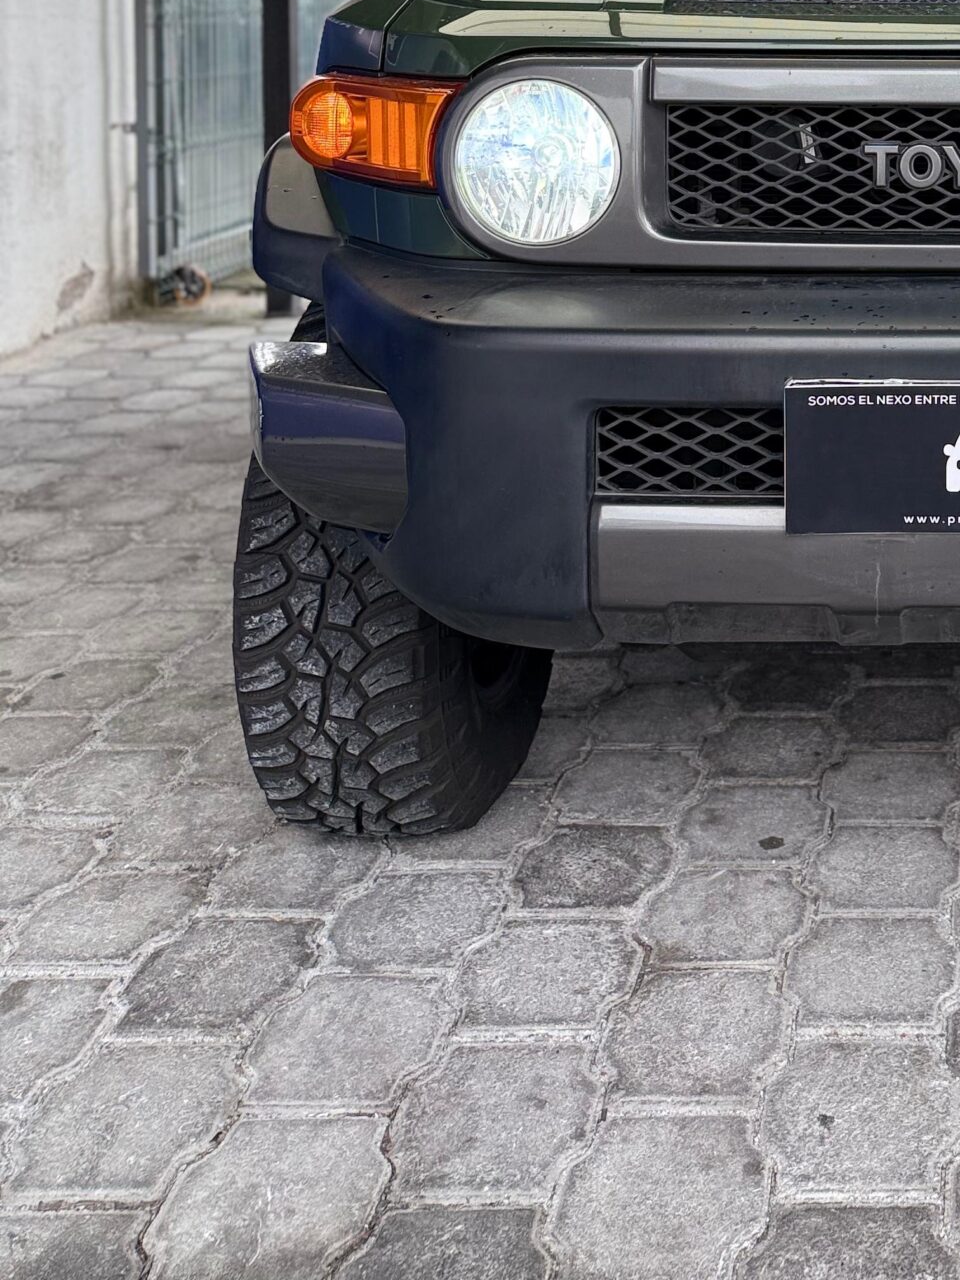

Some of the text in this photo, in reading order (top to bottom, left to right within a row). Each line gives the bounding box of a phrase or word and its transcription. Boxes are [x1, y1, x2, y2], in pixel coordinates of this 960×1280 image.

[808, 395, 856, 407] SOMOS
[858, 395, 874, 406] EL
[876, 394, 912, 406] NEXO
[914, 394, 957, 406] ENTRE
